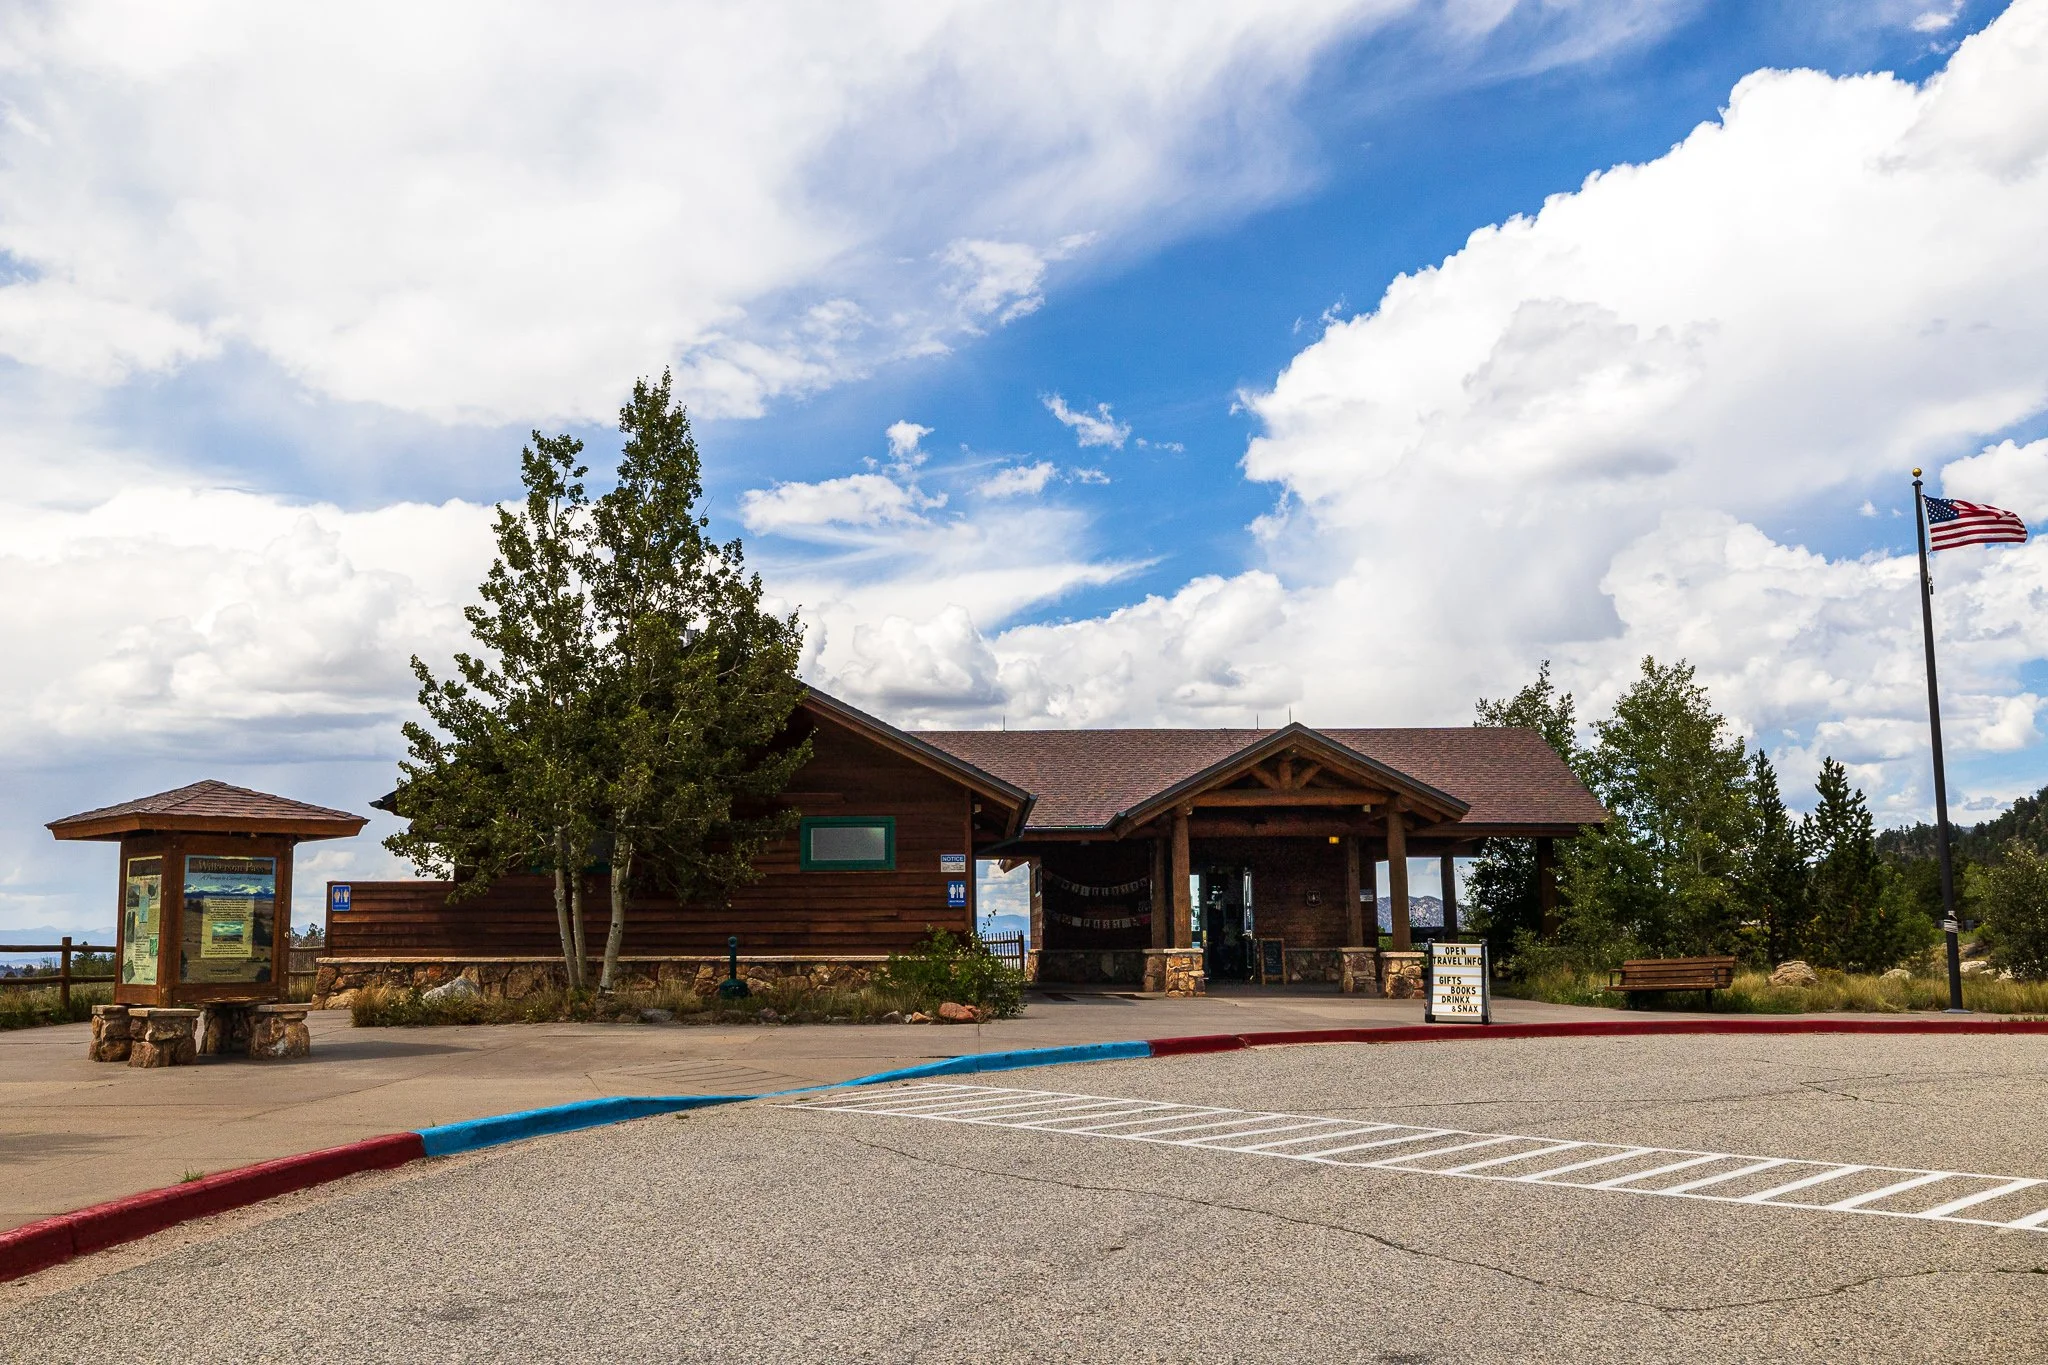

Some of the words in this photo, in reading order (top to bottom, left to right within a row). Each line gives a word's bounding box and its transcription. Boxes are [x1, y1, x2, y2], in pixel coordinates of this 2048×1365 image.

[199, 860, 243, 872] Wilkerson
[246, 861, 265, 872] Pass
[1445, 947, 1466, 955] OPEN
[1433, 956, 1462, 965] TRAVEL
[1464, 957, 1482, 965] INFO
[1439, 976, 1462, 985] GIFTS
[1451, 986, 1476, 995] BOOKS
[1441, 995, 1470, 1004] DRINKX
[1457, 1005, 1479, 1013] SNAX
